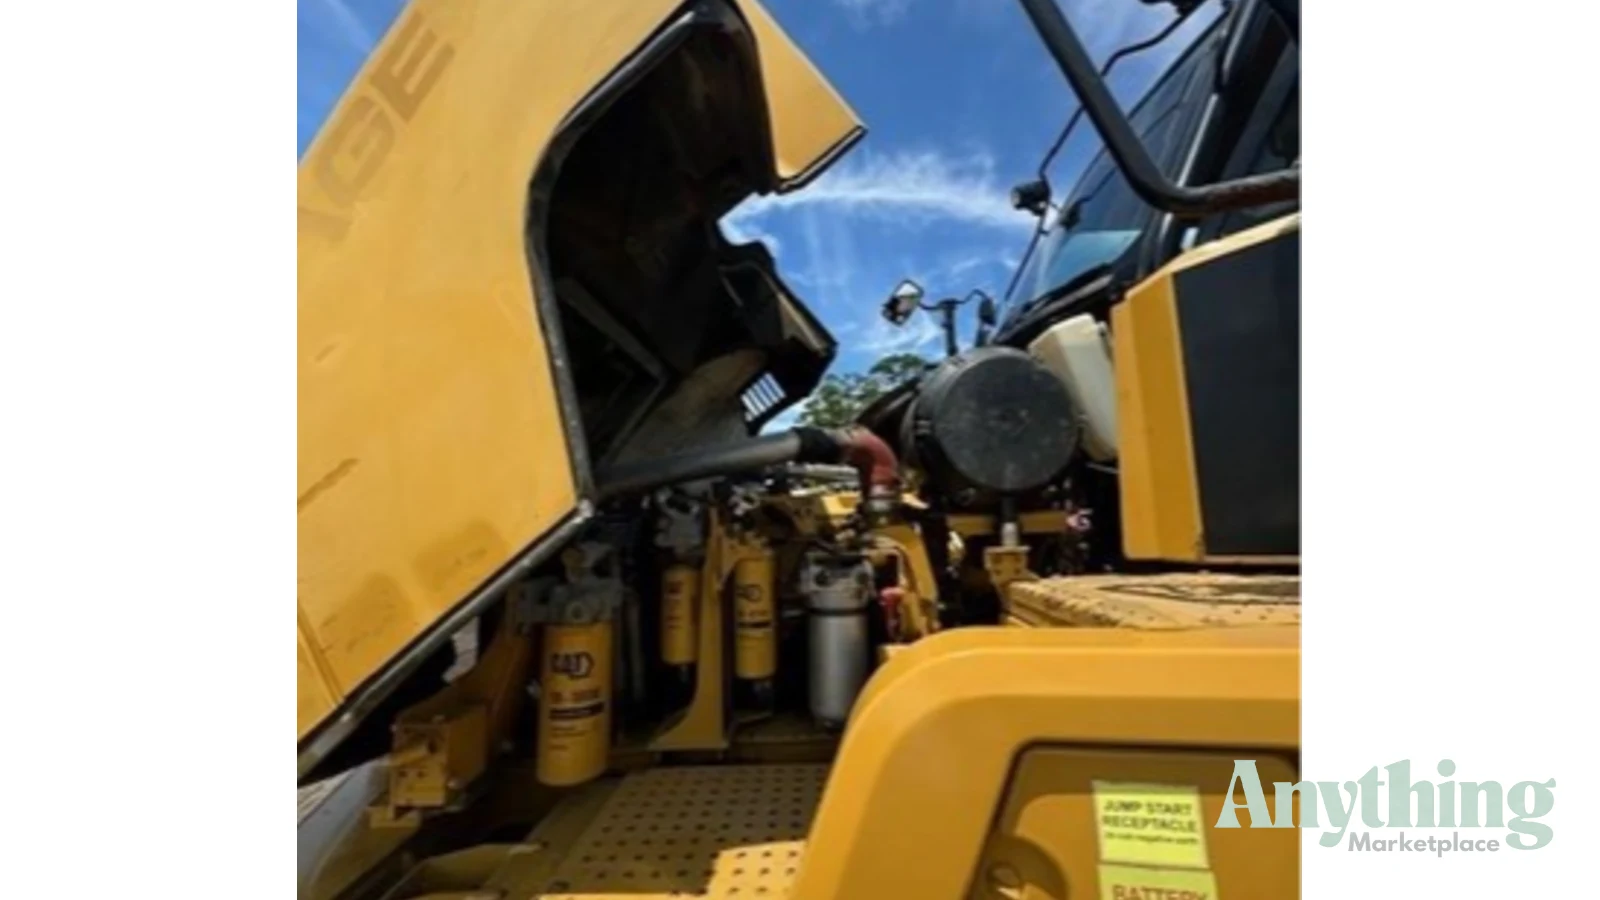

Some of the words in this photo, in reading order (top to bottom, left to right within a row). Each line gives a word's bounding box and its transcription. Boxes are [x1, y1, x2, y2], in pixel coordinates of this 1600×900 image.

[1103, 799, 1143, 814] JUMP
[1146, 802, 1194, 817] START
[1101, 814, 1198, 833] RECEPTACLE
